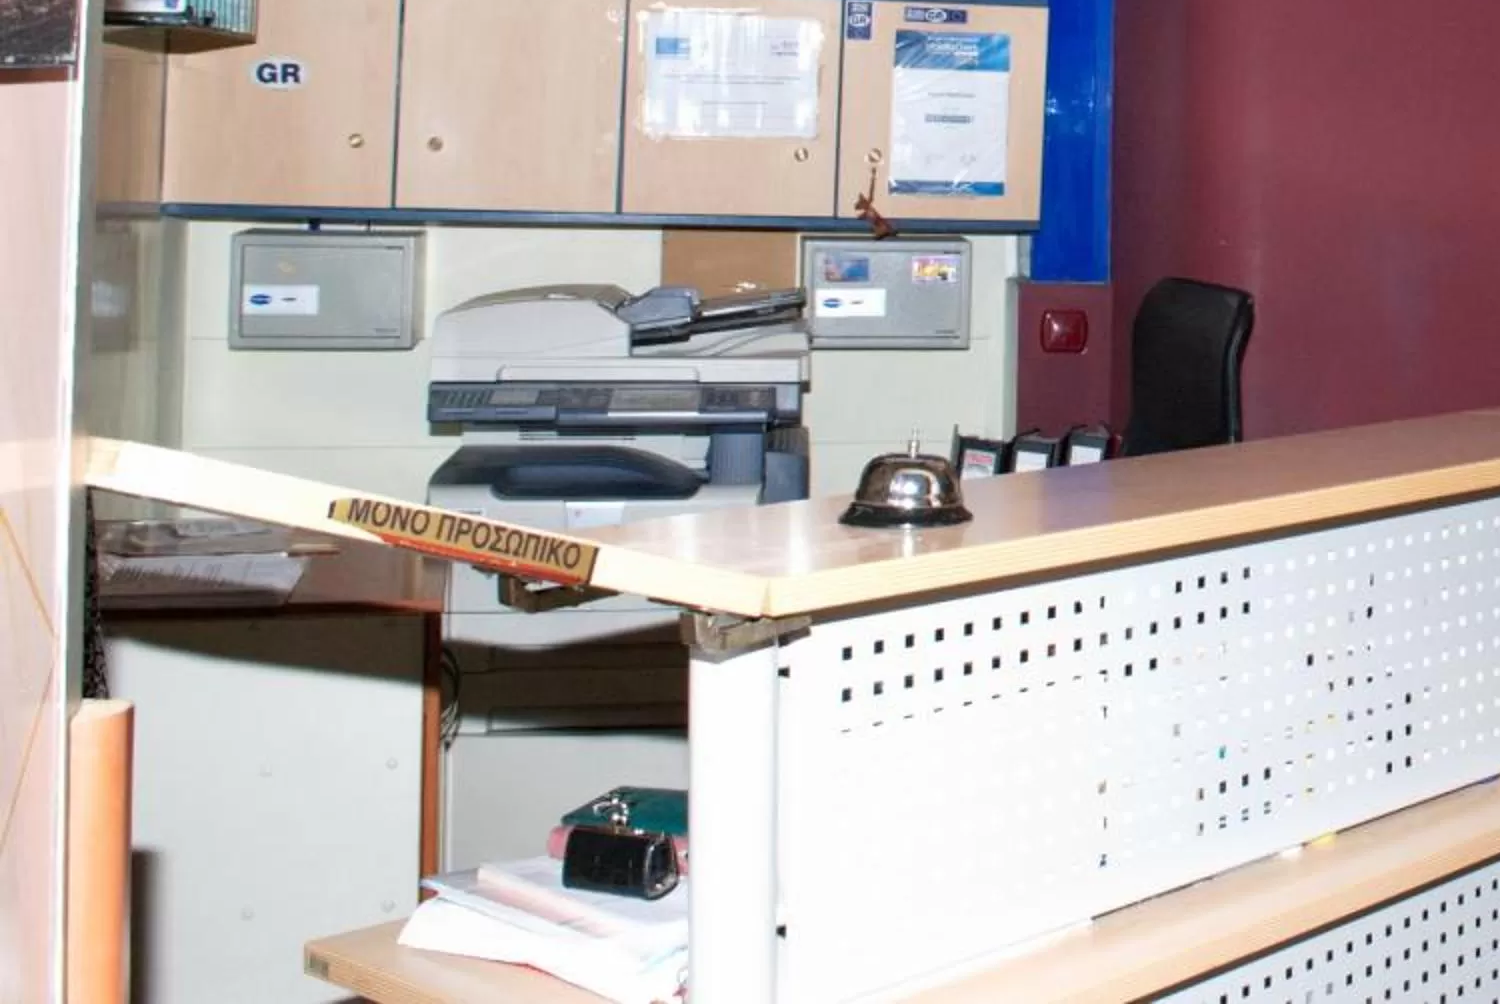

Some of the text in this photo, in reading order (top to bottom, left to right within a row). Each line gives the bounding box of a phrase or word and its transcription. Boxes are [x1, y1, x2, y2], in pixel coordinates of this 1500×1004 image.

[256, 62, 301, 84] GR
[348, 497, 582, 571] ΜΟΝΟ ΠΡΟΣΩΠΙΚΟ
